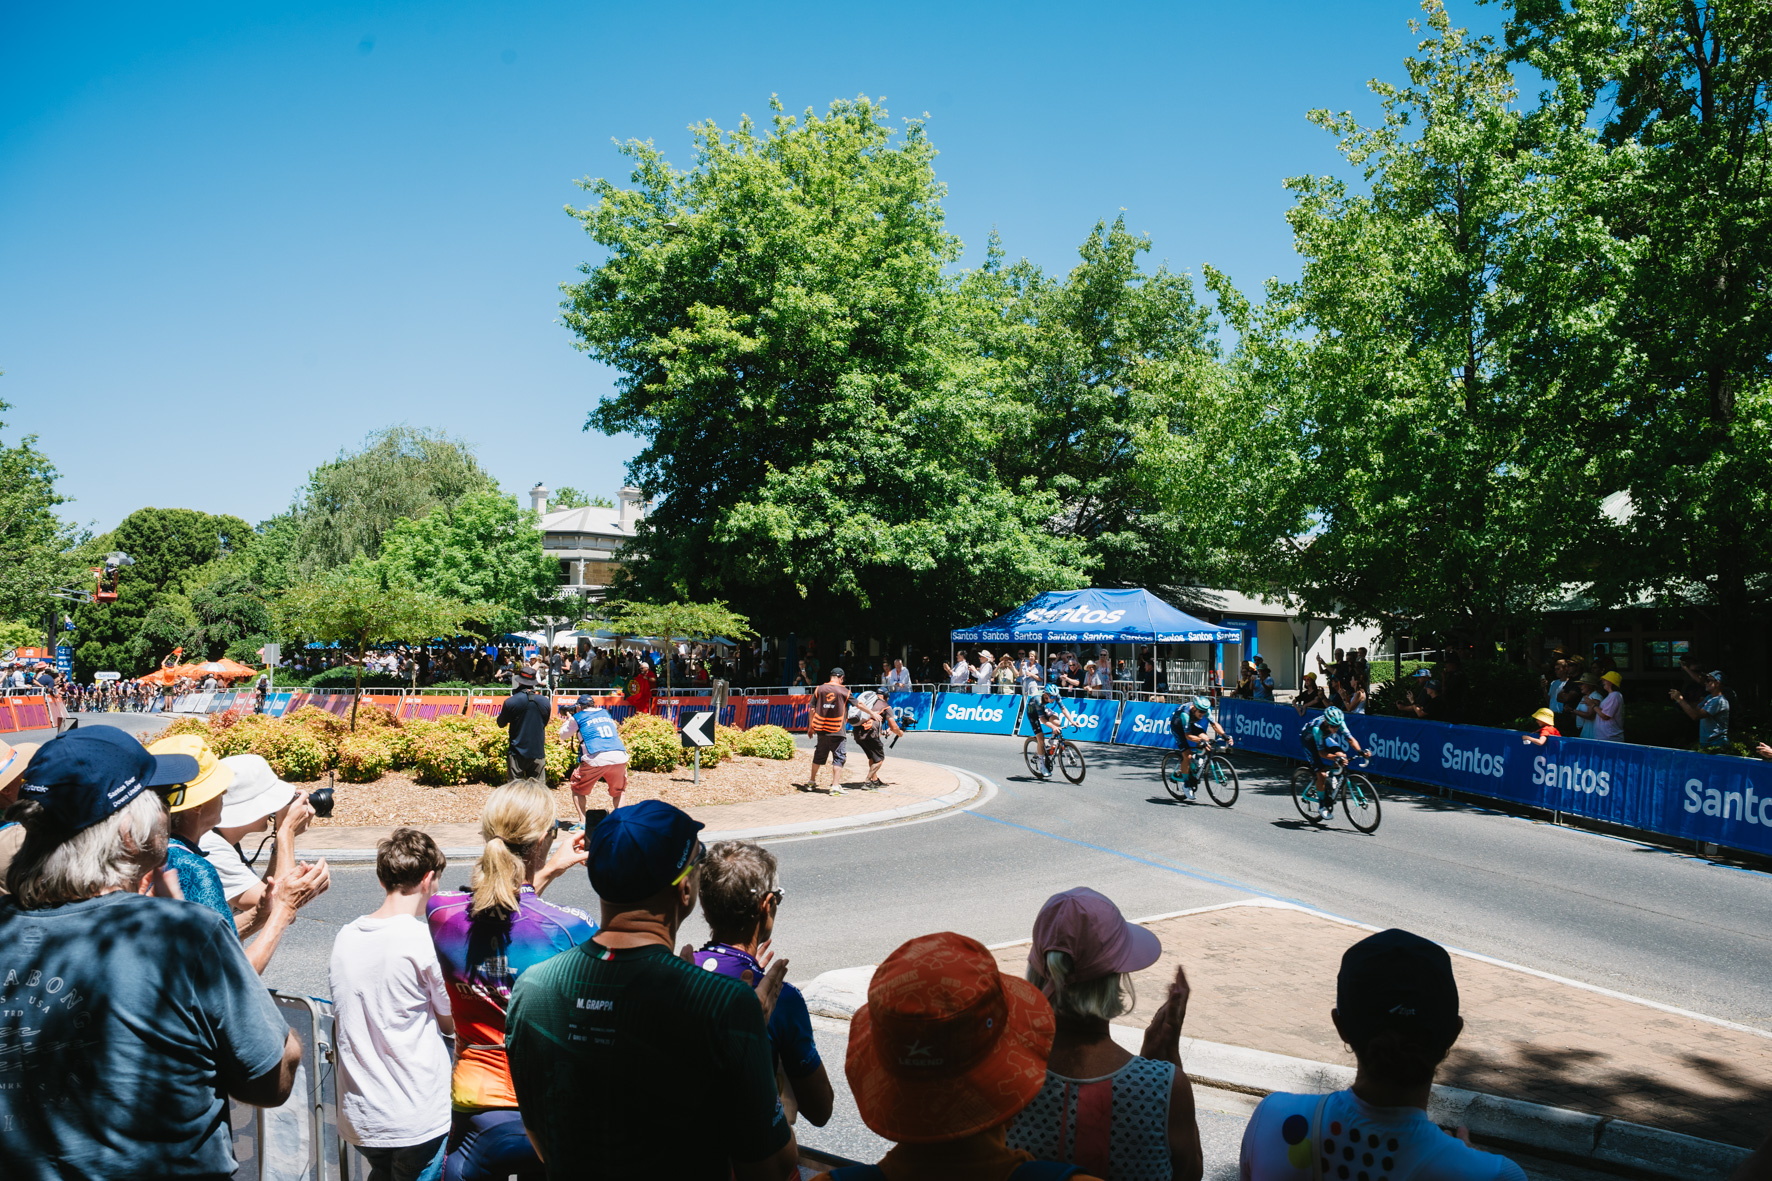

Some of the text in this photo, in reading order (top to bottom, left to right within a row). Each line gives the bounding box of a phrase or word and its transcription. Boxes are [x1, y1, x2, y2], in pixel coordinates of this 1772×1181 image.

[1016, 605, 1126, 624] Santos
[952, 631, 979, 641] Santos
[982, 631, 1010, 641] Santos
[1014, 631, 1043, 641] Santos
[1047, 631, 1078, 641] Santos
[1081, 632, 1114, 641] Santos
[1157, 631, 1240, 642] Santos Santos Santos
[744, 704, 768, 729] TOUR
[768, 704, 794, 729] DOWN
[945, 703, 1003, 722] Santos
[1050, 711, 1099, 729] ntos
[597, 725, 613, 739] 10
[1132, 714, 1172, 735] Sant
[1235, 714, 1282, 741] Santos
[1368, 733, 1420, 764] Santos
[1441, 742, 1505, 778] Santos
[1531, 756, 1611, 797] Santos
[1683, 778, 1772, 828] Santo
[107, 776, 136, 800] Santos Tour
[112, 783, 143, 808] Down Under
[3, 969, 93, 1029] ABONG
[28, 995, 51, 1014] USA
[576, 997, 614, 1012] M. GRAPPA
[3, 1009, 24, 1017] TRD
[898, 1057, 944, 1066] LEGEND
